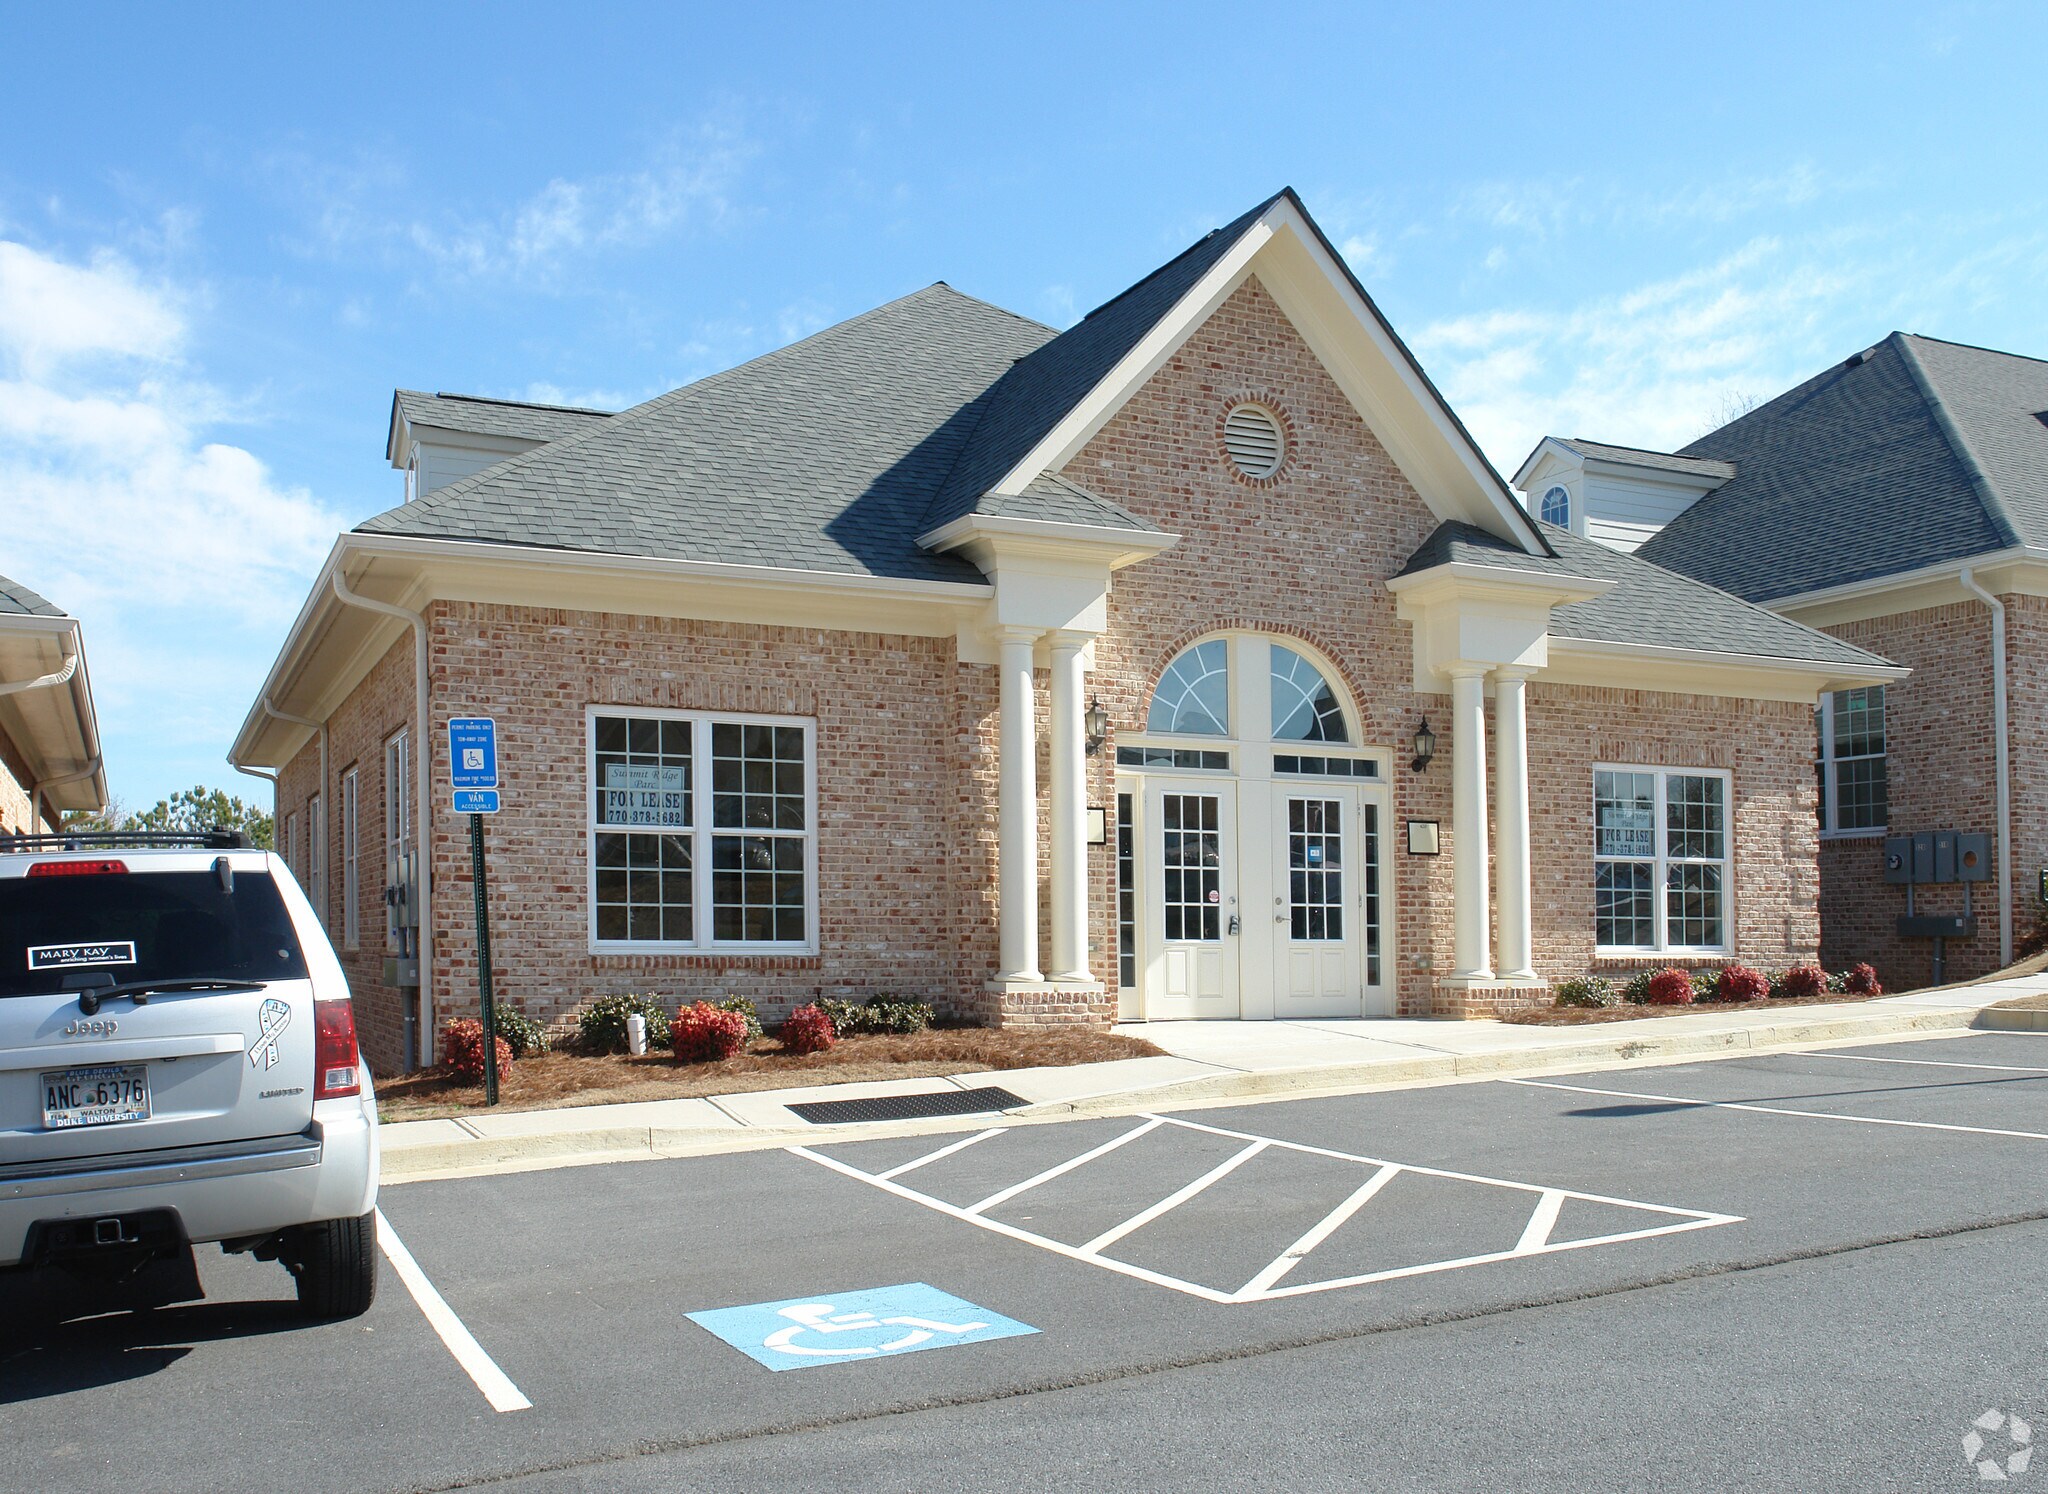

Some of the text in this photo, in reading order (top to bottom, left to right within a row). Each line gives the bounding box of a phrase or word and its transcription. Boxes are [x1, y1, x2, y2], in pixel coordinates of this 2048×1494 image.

[652, 770, 678, 782] Rdge
[634, 780, 656, 788] Parc
[468, 794, 484, 802] VAN
[610, 791, 634, 807] FOR
[40, 947, 110, 959] MARY KAY
[65, 1019, 118, 1036] Jeep
[69, 1067, 120, 1077] BLUE DEVILS
[48, 1079, 144, 1110] ANC 6376
[80, 1108, 116, 1116] WALTON
[57, 1112, 140, 1127] DUKE UNIVERSITY
